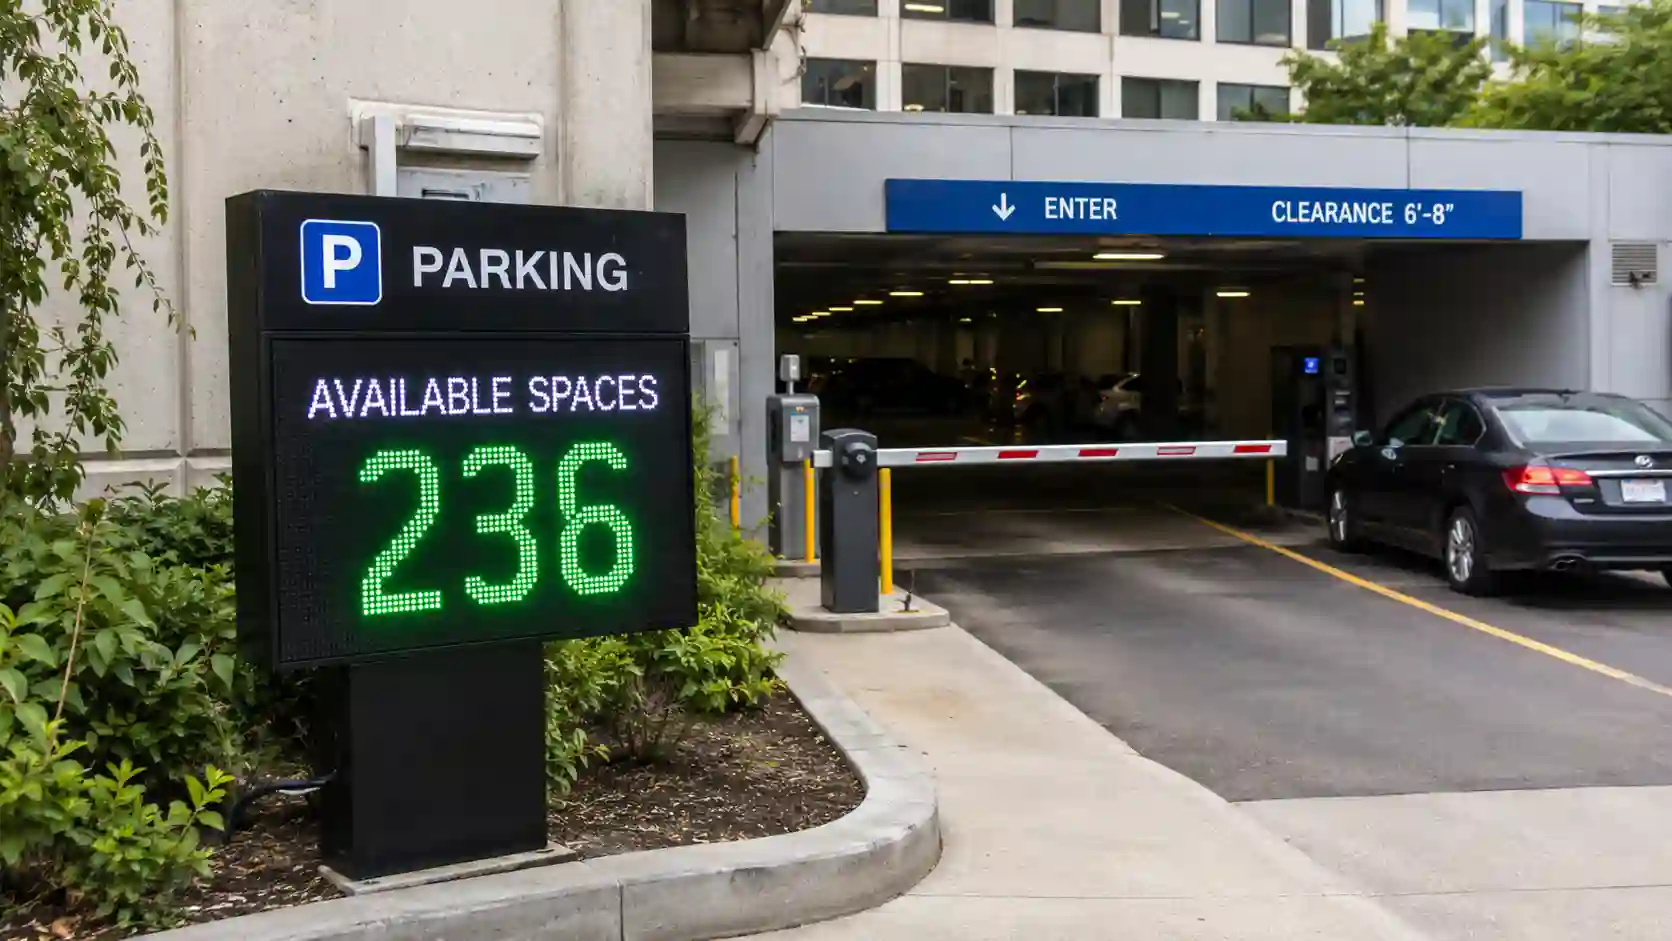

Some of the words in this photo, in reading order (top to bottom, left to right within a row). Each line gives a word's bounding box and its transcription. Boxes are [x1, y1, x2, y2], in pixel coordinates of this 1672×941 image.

[1045, 196, 1118, 221] ENTER
[1271, 200, 1394, 225] CLEARANCE
[321, 234, 363, 289] P
[412, 245, 629, 293] PARKING
[307, 376, 514, 420] AVAILABLE
[528, 374, 659, 414] SPACES
[358, 441, 637, 617] 236
